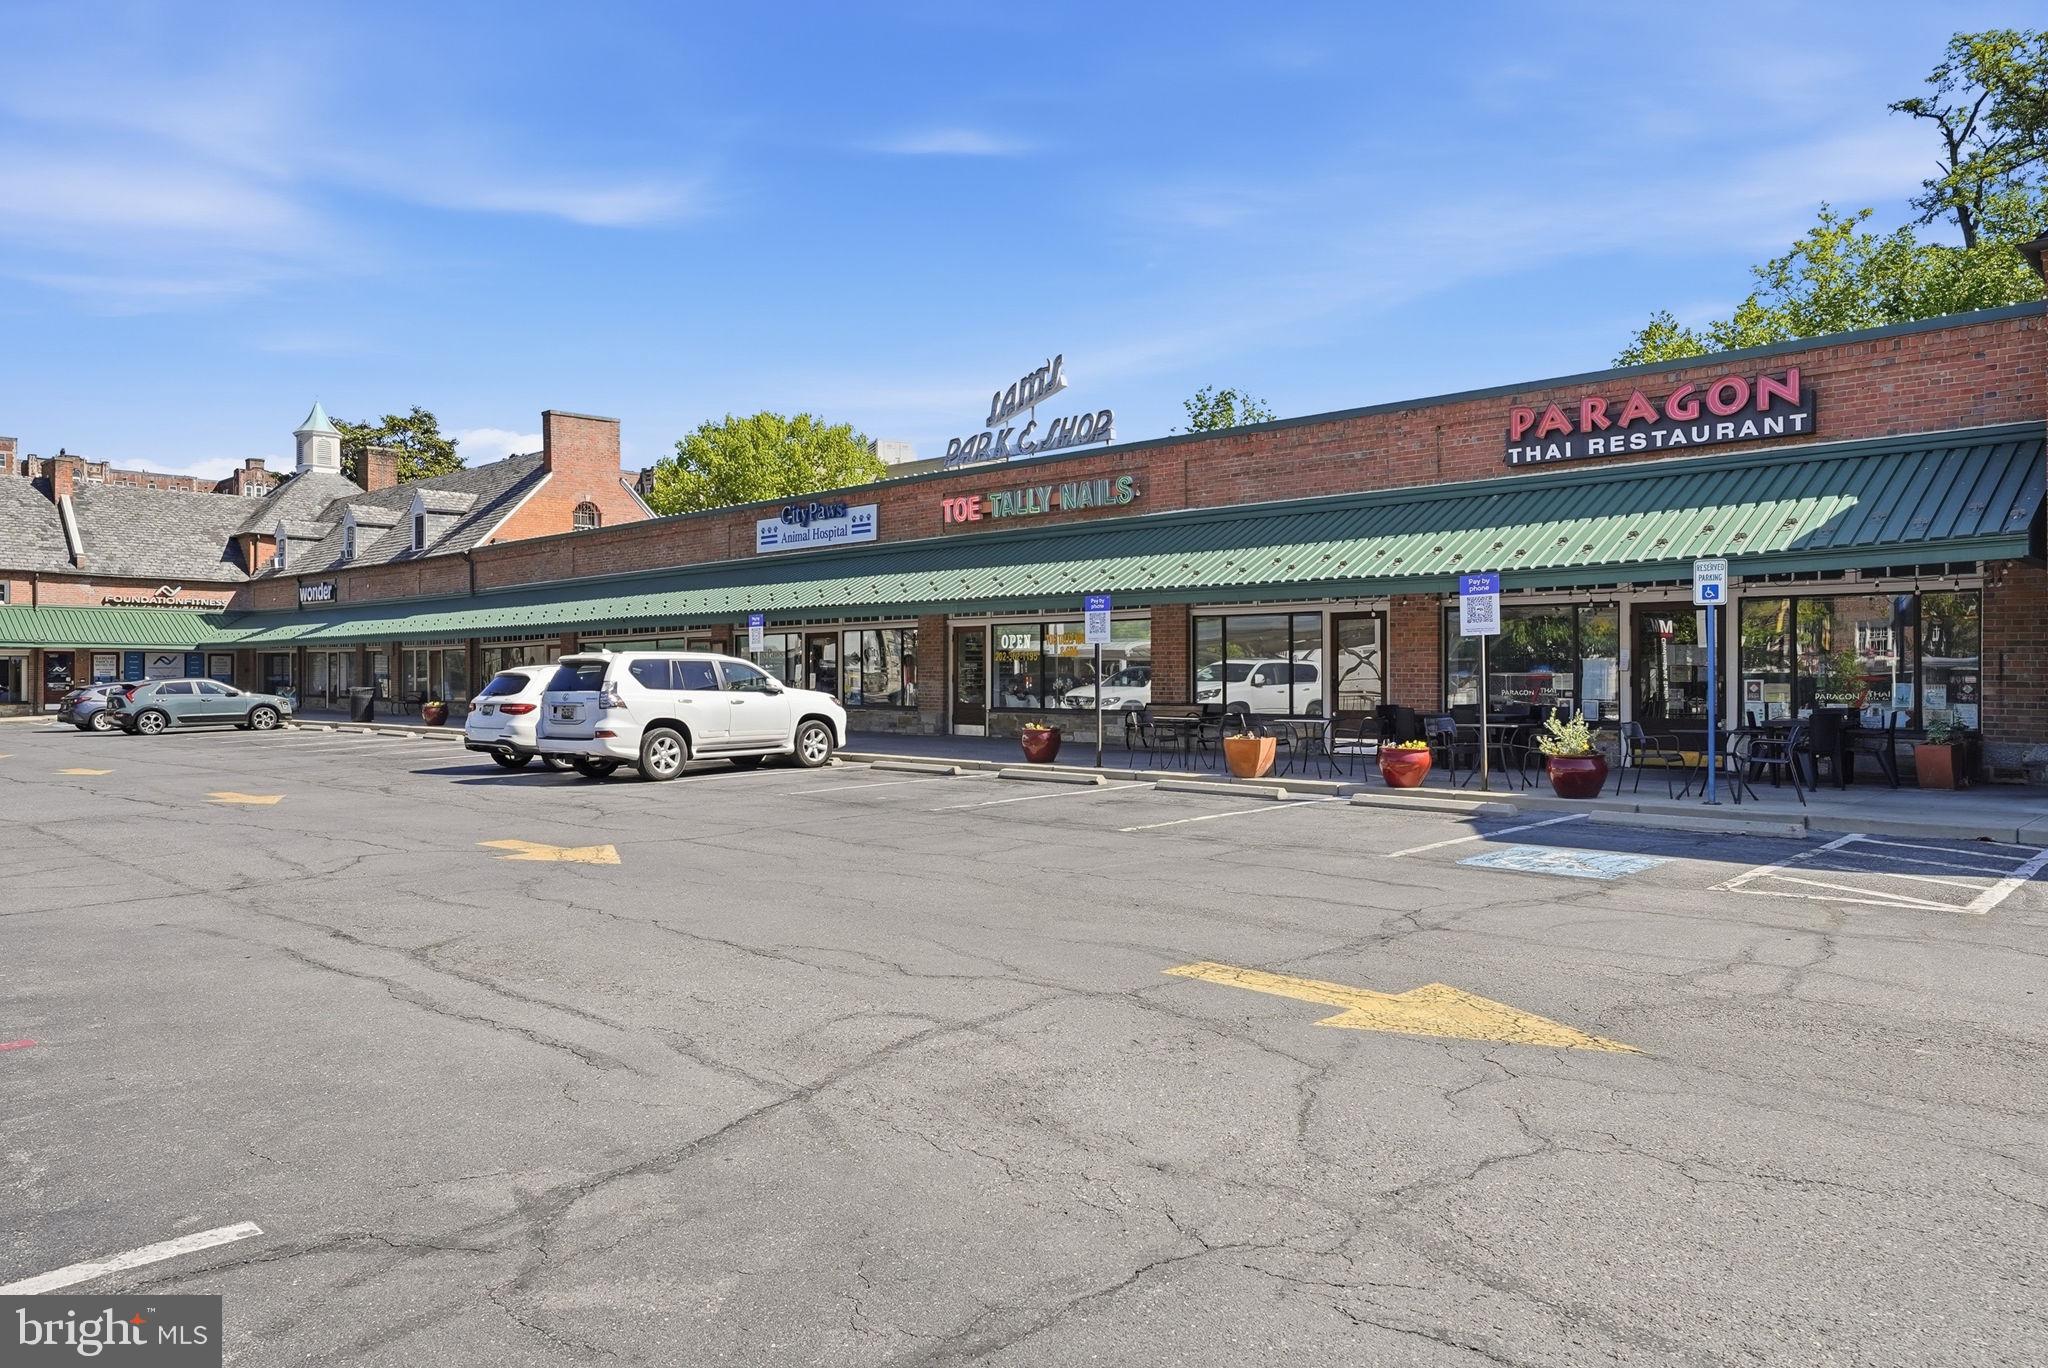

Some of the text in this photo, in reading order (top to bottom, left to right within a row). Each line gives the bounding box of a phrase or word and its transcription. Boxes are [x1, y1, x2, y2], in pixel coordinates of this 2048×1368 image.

[1509, 367, 1801, 442] PARAGON
[944, 427, 1015, 467] PARK
[1040, 409, 1114, 450] SHOP
[1508, 413, 1808, 464] THAI RESTAURANT
[943, 476, 1135, 523] TOE TALLY NAILS
[781, 524, 848, 544] Animal Hospital
[1696, 563, 1725, 572] RESERVED
[299, 582, 332, 602] wonder
[1001, 634, 1031, 649] OPEN
[1814, 692, 1860, 700] PARAGON
[1867, 690, 1891, 698] THAI
